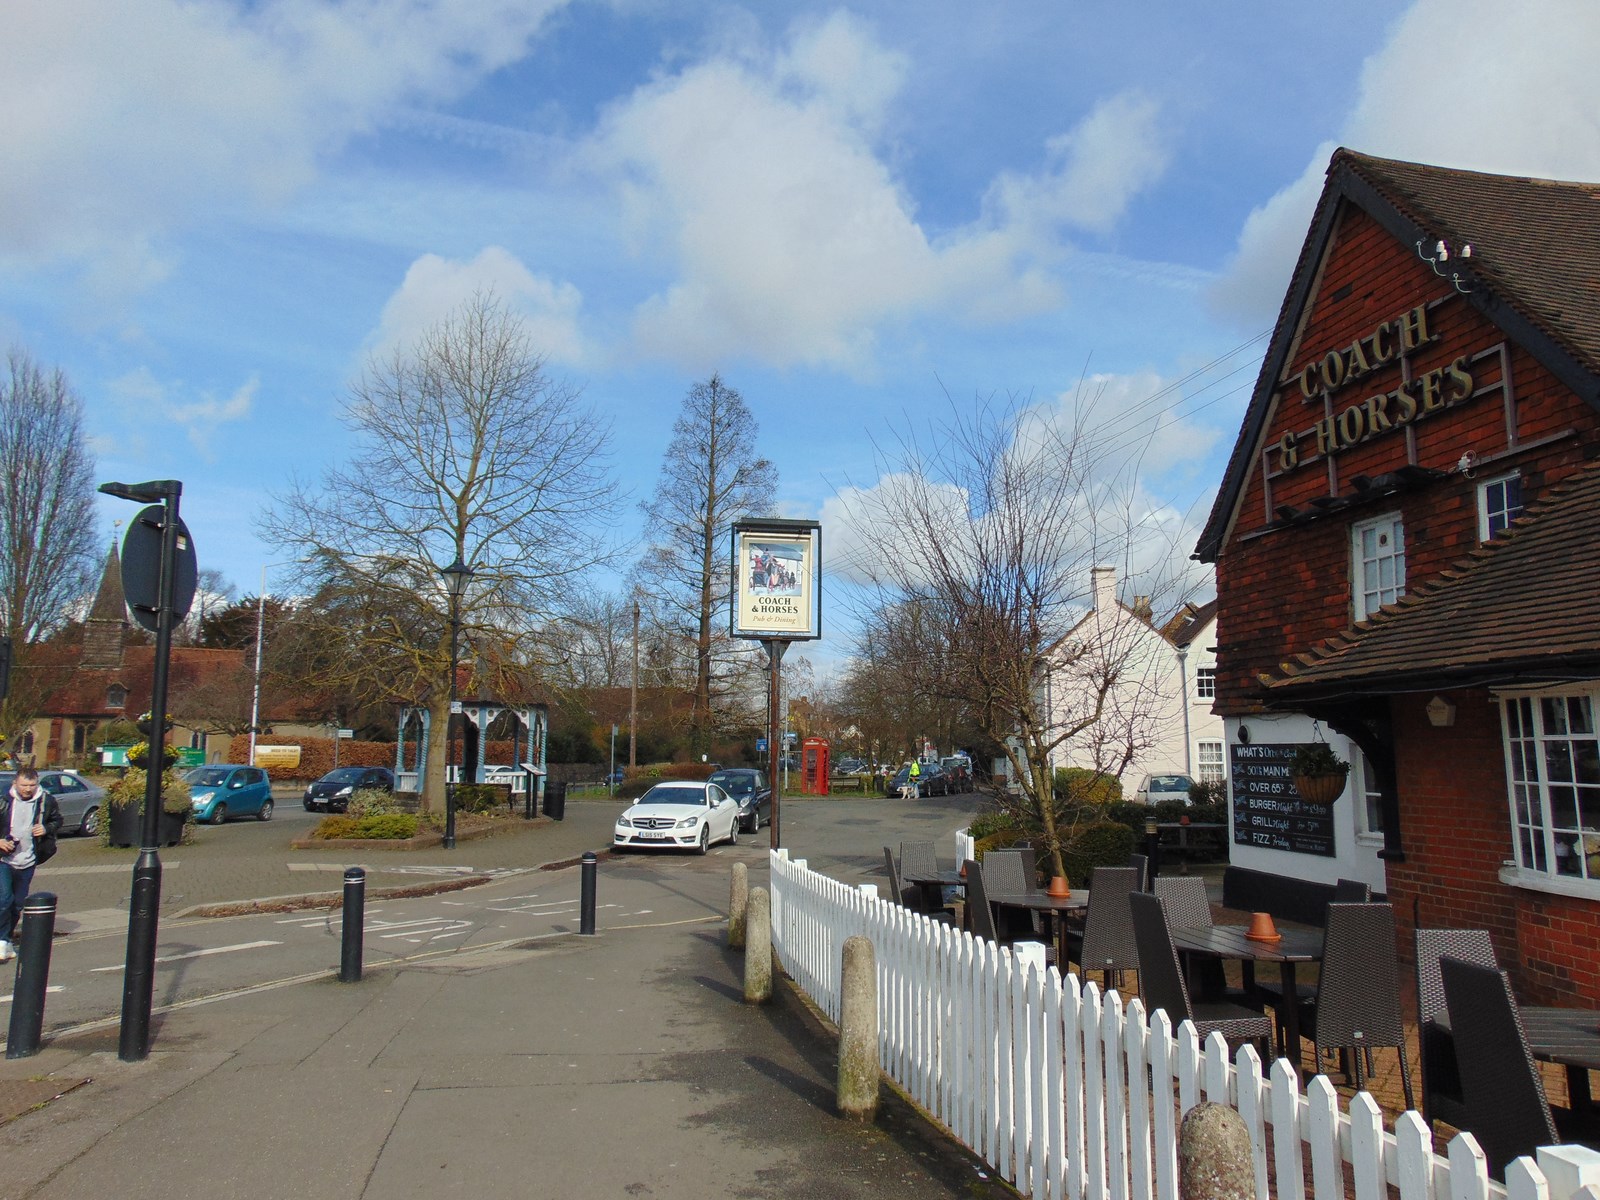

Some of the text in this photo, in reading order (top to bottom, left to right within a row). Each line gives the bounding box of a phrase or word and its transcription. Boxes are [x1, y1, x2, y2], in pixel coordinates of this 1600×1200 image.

[1301, 303, 1430, 399] COACH
[1279, 355, 1474, 472] & HORSES
[758, 596, 791, 605] COACH
[751, 605, 799, 614] & HORSES
[774, 616, 796, 625] Dining
[1236, 747, 1263, 758] WHAT'S
[1250, 782, 1270, 793] OVER
[1249, 798, 1277, 811] BURGER
[1251, 815, 1273, 828] GRILL
[1252, 832, 1270, 845] FIZZ
